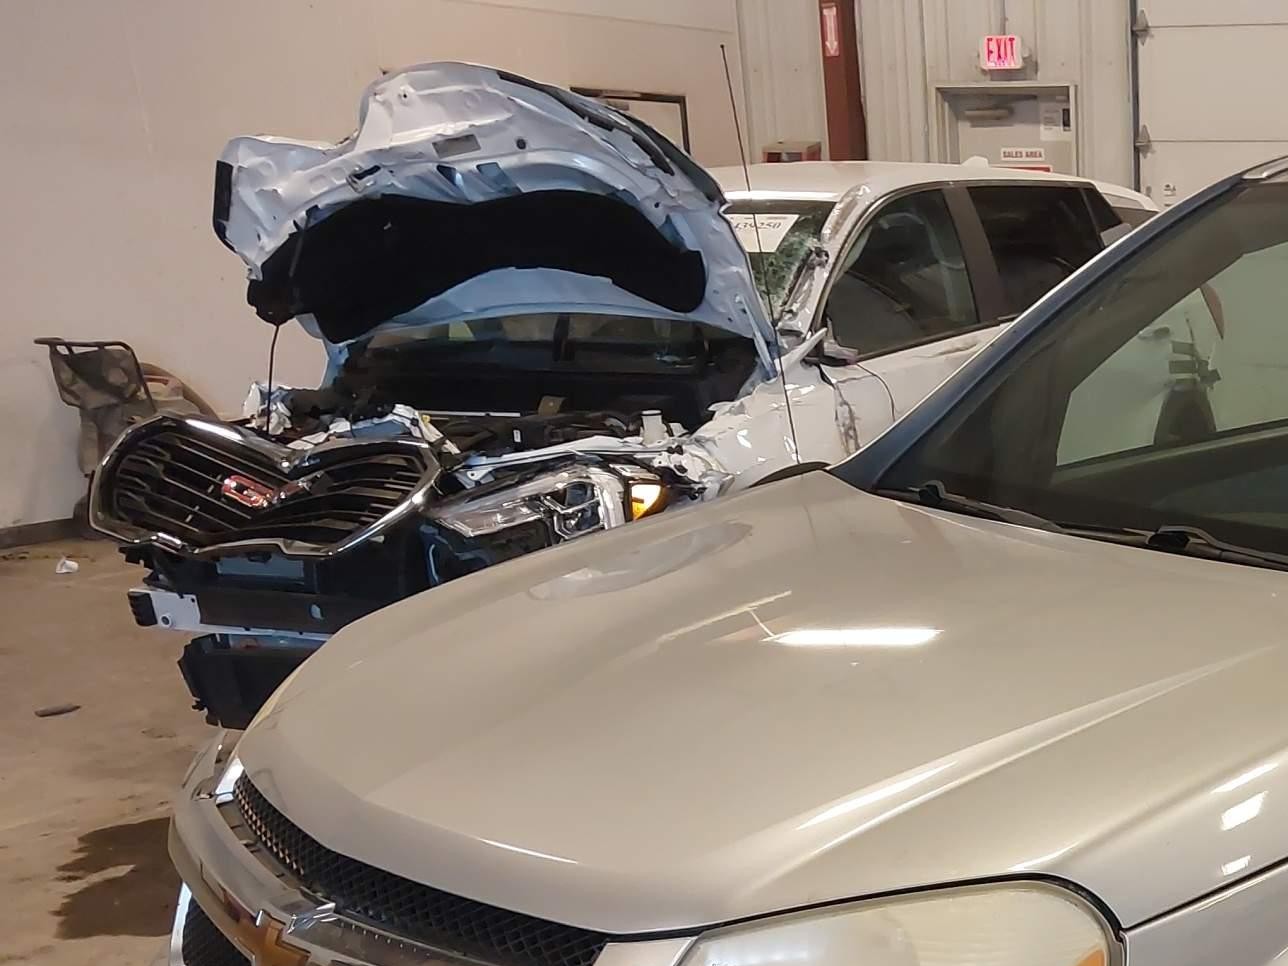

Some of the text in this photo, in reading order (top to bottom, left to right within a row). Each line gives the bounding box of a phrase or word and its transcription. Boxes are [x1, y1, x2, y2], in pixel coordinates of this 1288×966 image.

[986, 37, 1016, 64] EXIT
[1002, 150, 1043, 159] SALES AREA
